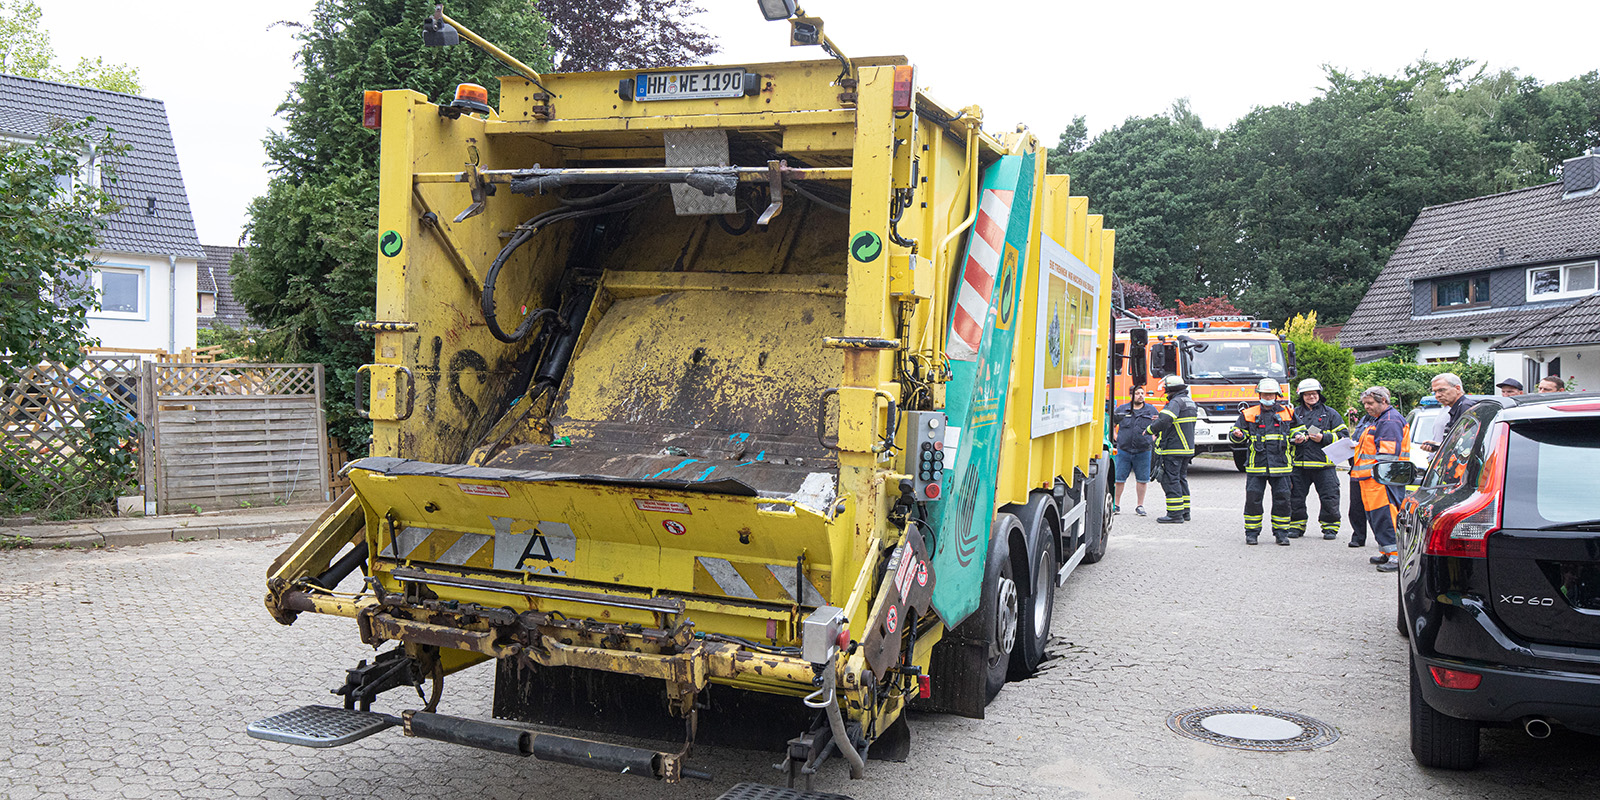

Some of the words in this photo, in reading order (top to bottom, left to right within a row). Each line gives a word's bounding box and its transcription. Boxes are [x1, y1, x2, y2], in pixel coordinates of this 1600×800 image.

[647, 76, 667, 94] HH
[679, 75, 699, 92] WE
[702, 72, 741, 91] 1190
[515, 528, 559, 574] A
